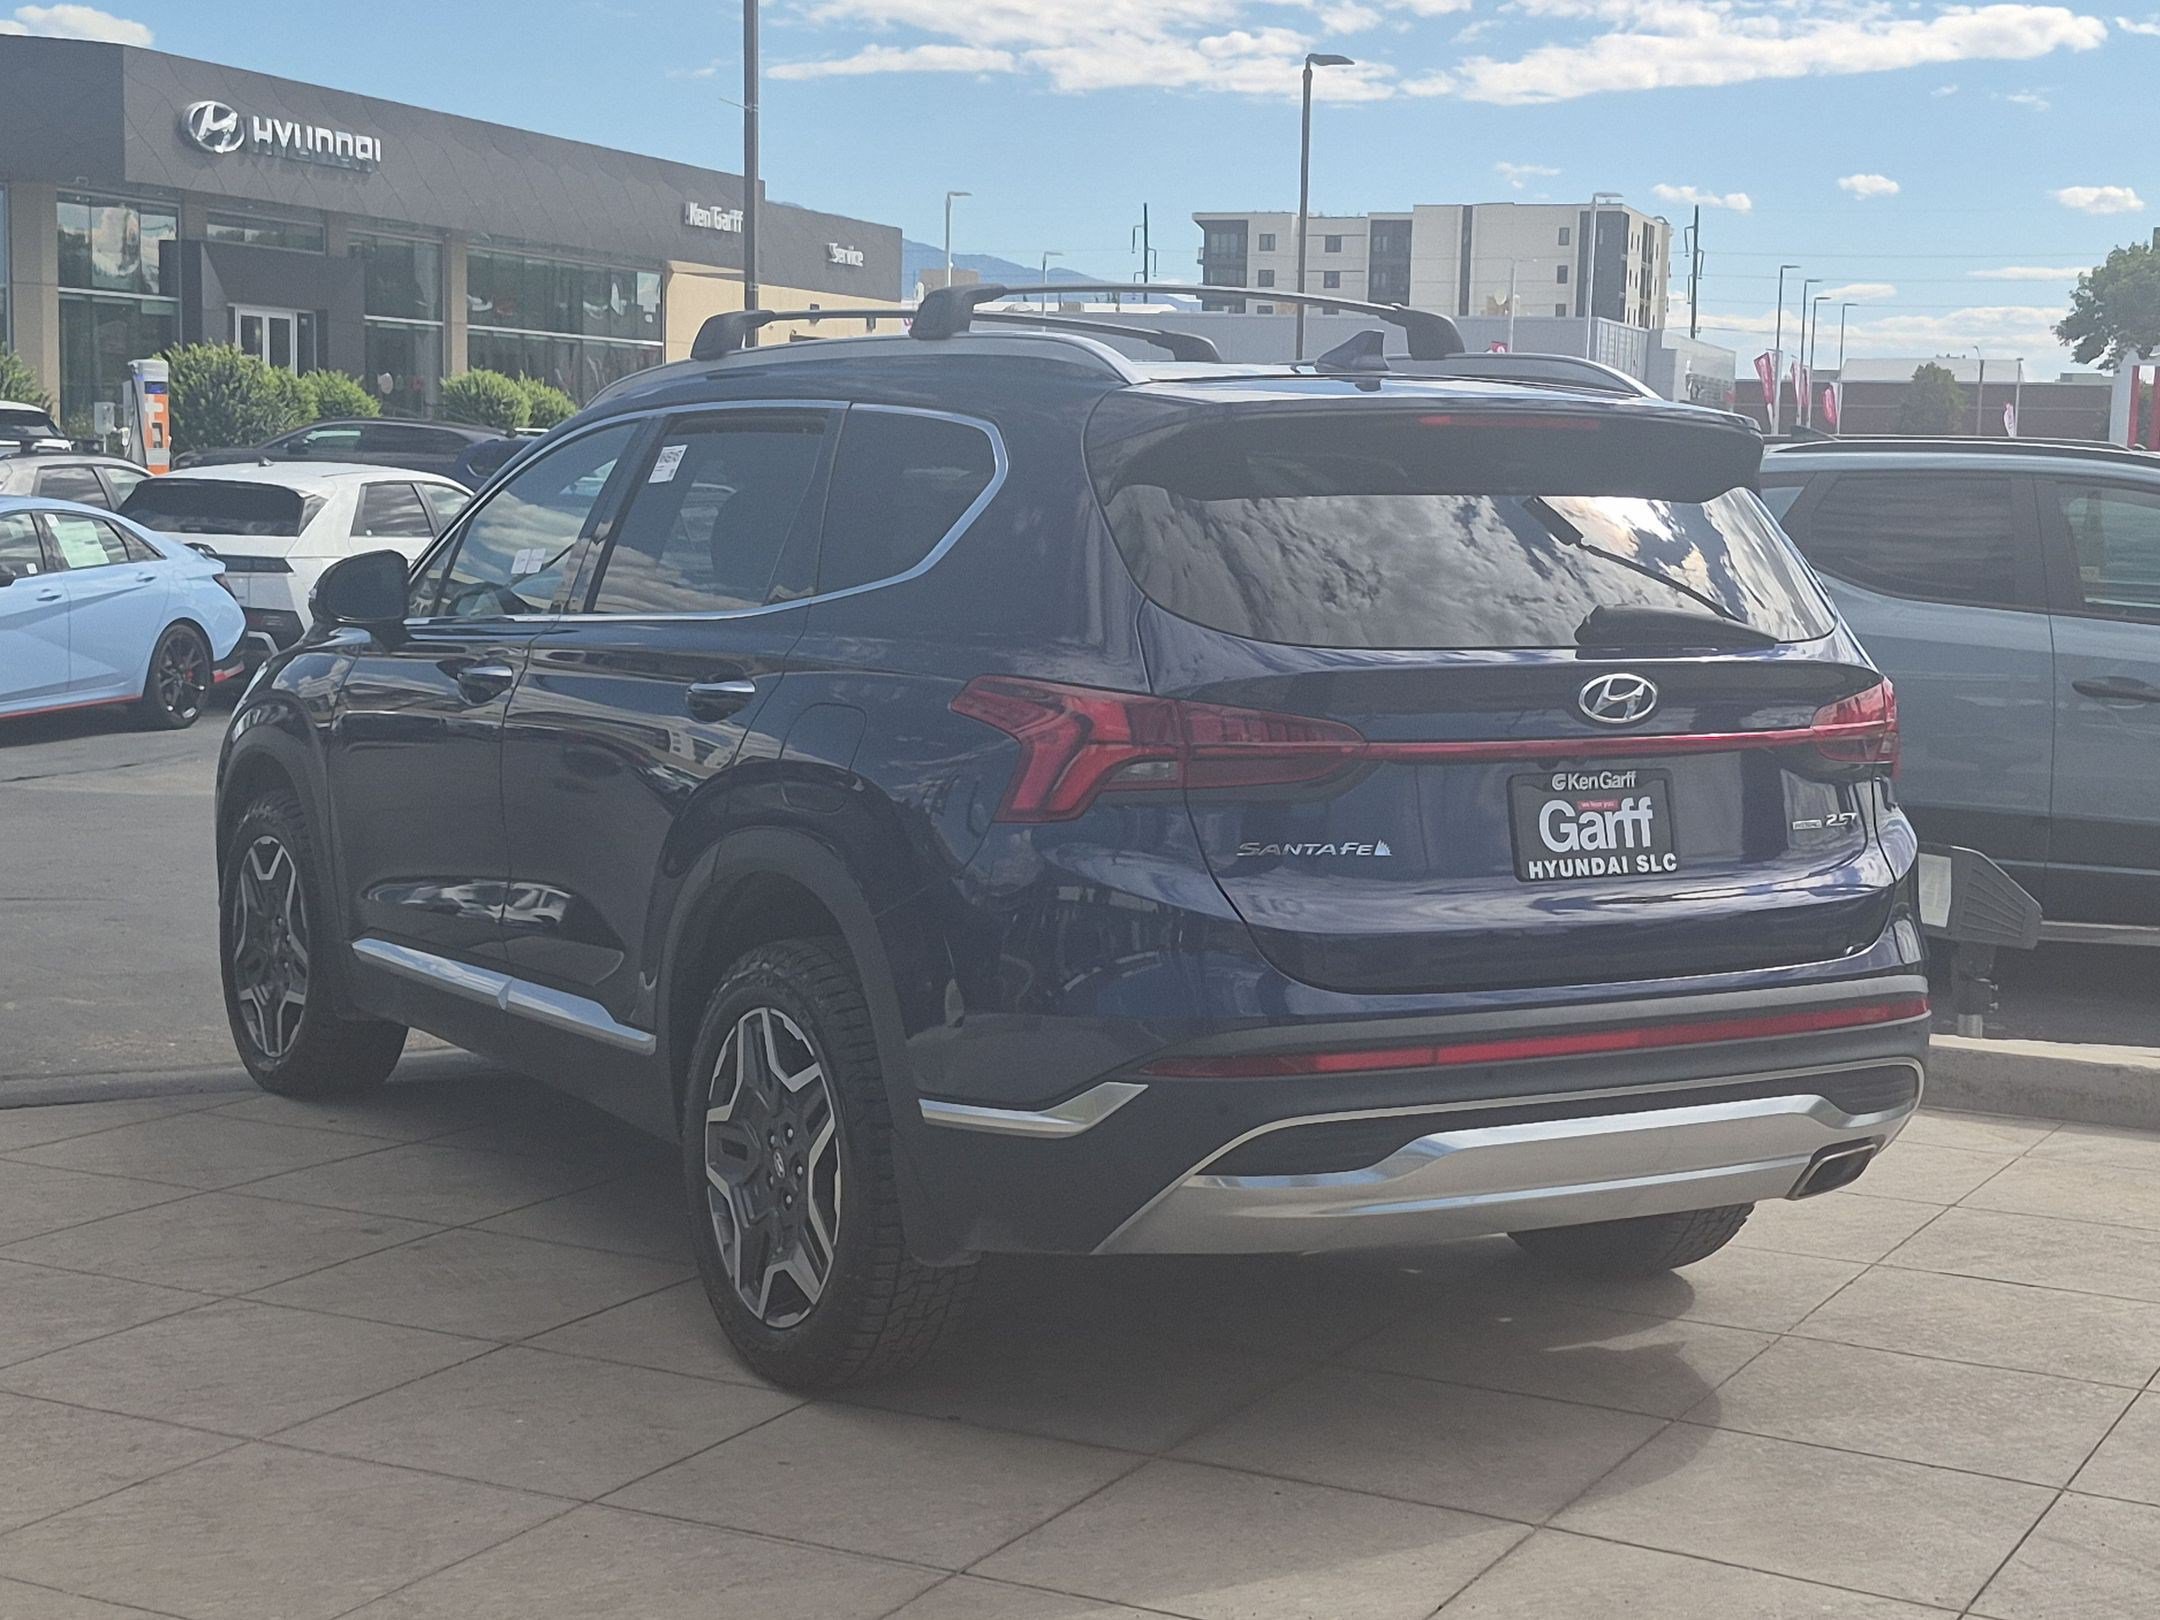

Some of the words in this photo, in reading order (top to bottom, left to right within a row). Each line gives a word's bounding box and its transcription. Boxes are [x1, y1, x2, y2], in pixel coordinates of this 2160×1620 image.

[686, 202, 712, 228] Ken
[829, 242, 864, 267] Service
[1567, 772, 1599, 791] Ken
[1599, 770, 1637, 790] Garff
[1538, 796, 1654, 853] Garff
[1528, 855, 1629, 880] HYUNDAI
[1636, 852, 1678, 874] SLC
